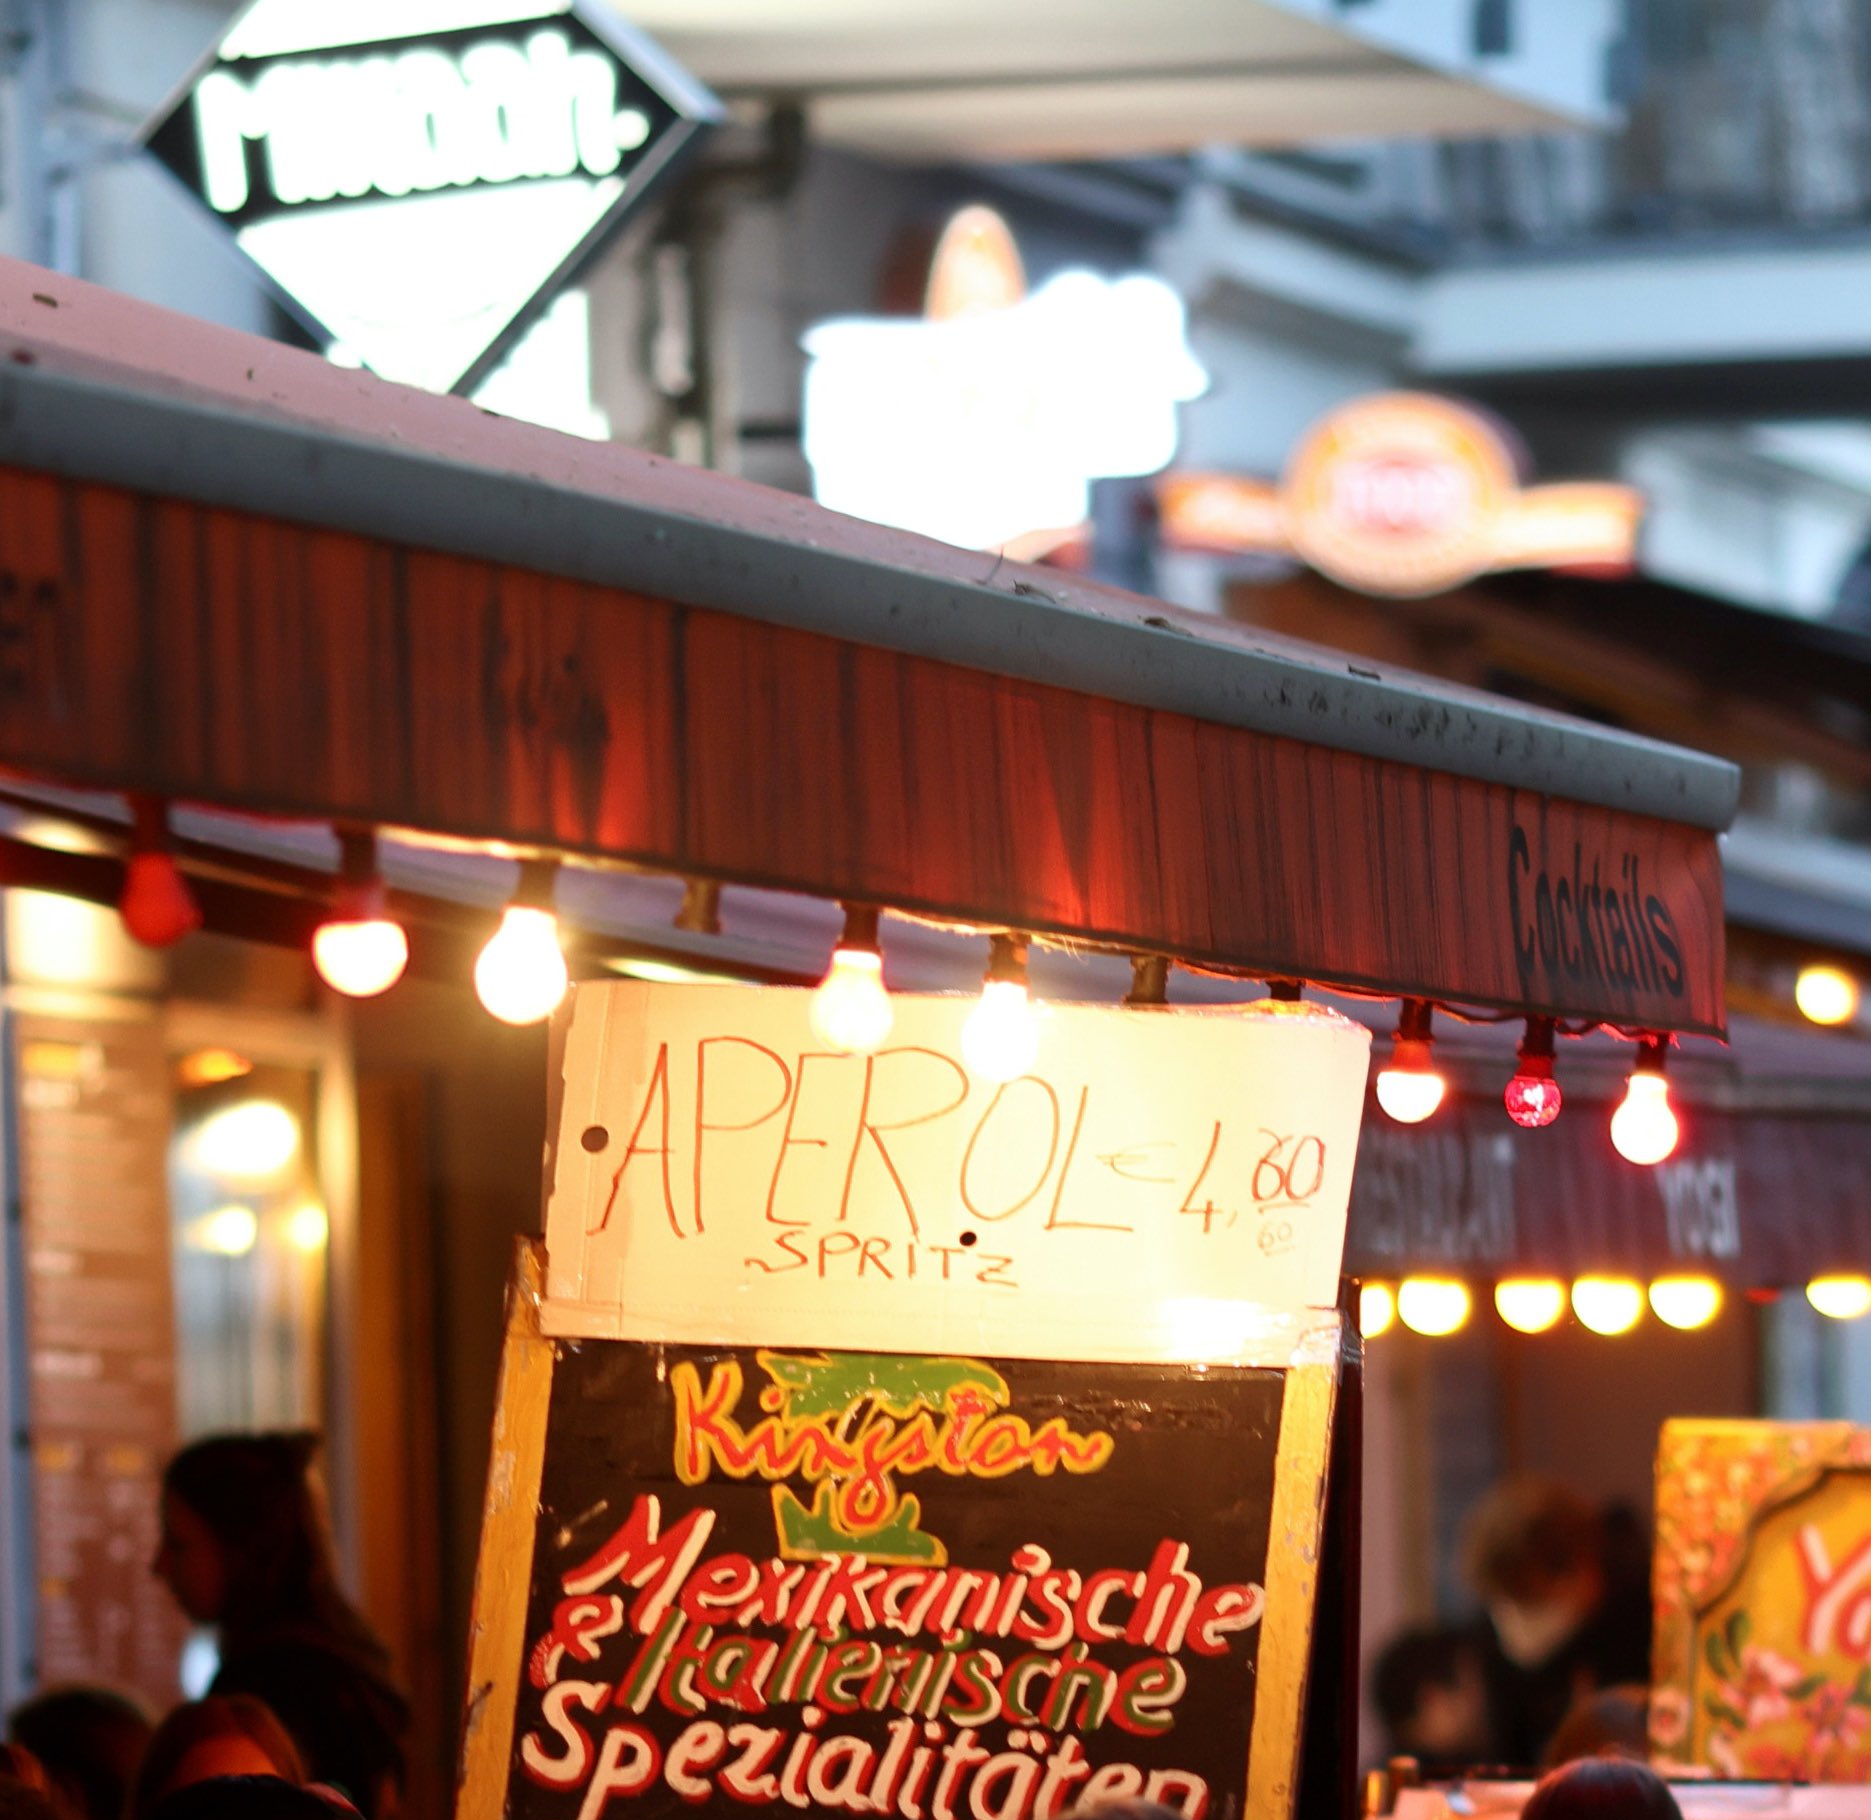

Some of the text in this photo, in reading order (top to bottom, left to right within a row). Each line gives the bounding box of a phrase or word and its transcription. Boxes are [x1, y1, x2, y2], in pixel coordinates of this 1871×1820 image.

[1508, 824, 1684, 999] Cocktails
[586, 1035, 1134, 1244] APEROL
[743, 1229, 1019, 1287] SPRITZ
[671, 1360, 1115, 1534] Kingston
[562, 1494, 1268, 1656] Mexikanische
[616, 1605, 1188, 1736] Italienische
